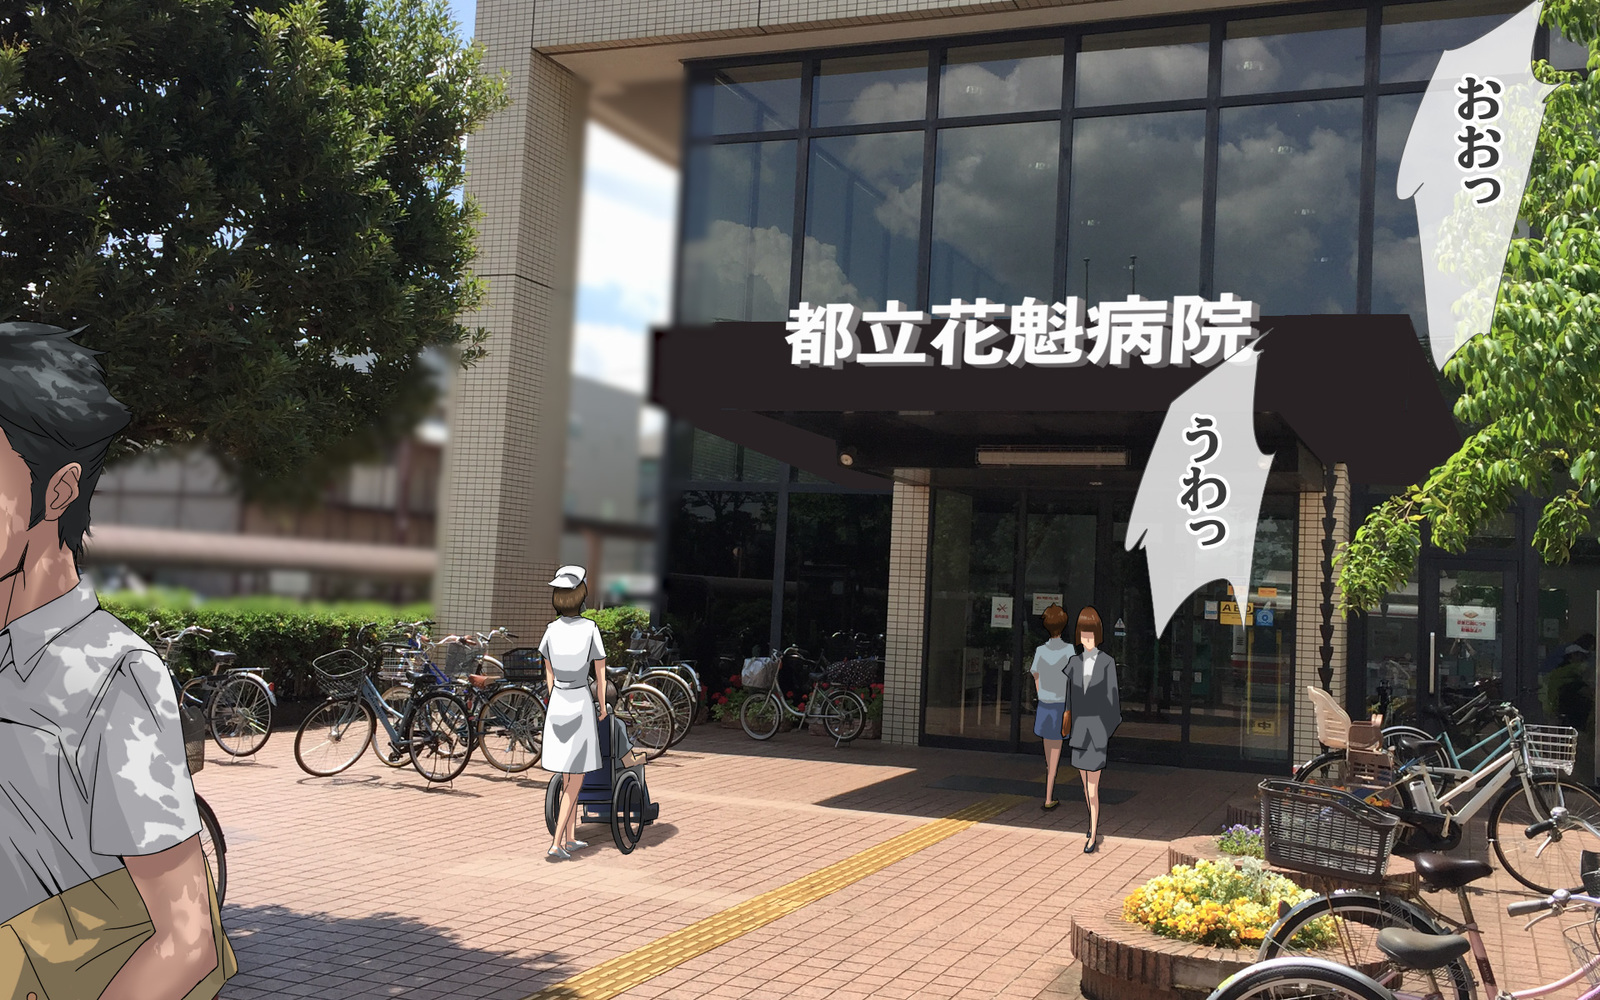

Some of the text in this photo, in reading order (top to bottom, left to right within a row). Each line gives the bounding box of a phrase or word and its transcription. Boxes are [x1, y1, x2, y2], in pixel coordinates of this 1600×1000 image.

[784, 292, 1255, 368] 都立花魁病院
